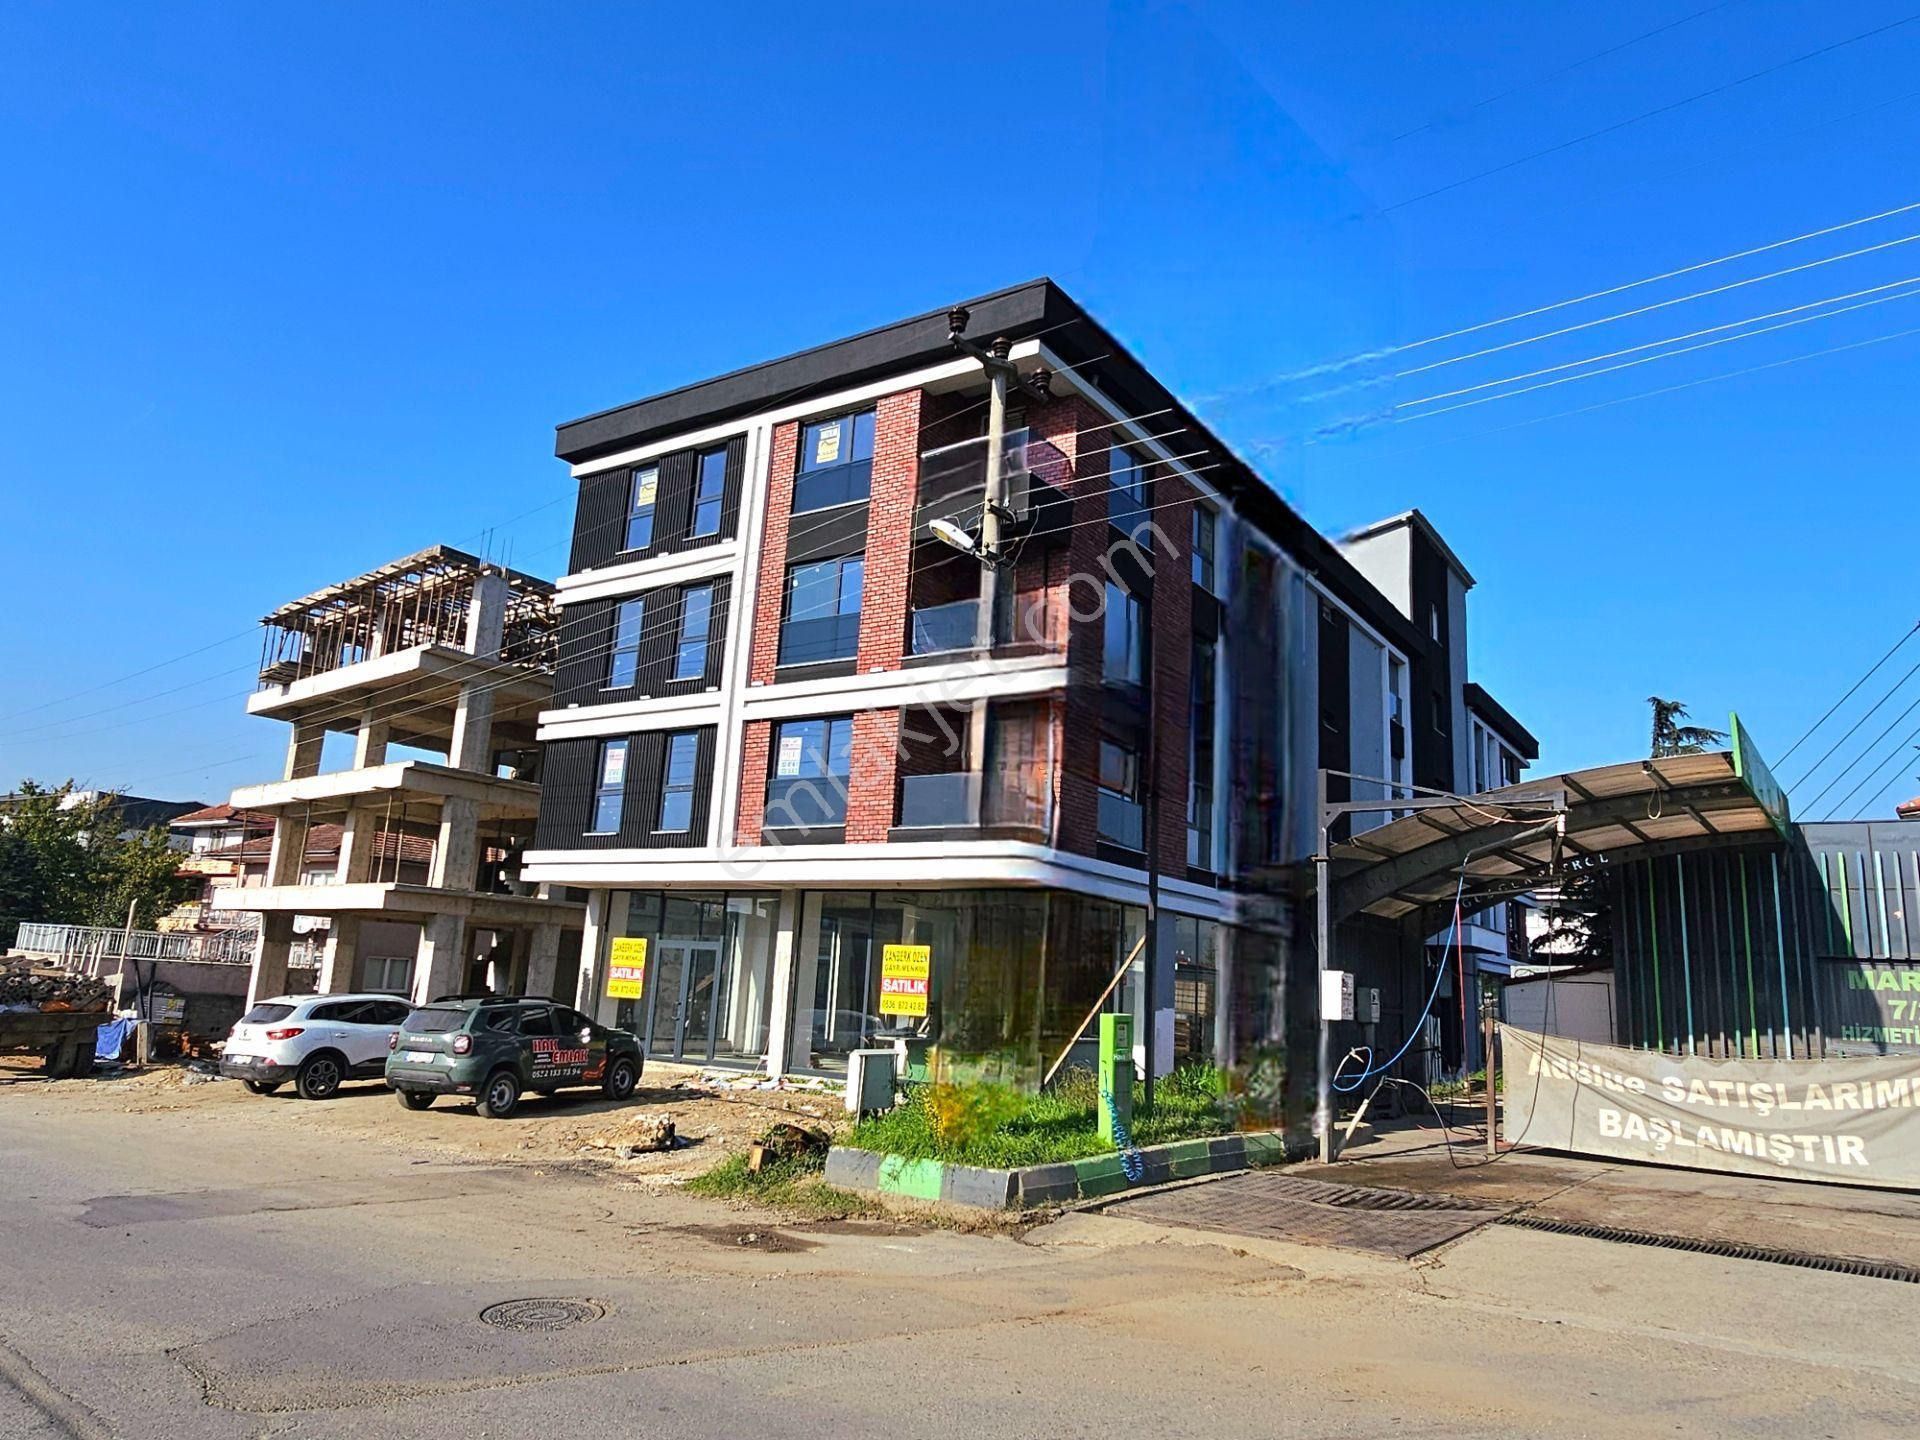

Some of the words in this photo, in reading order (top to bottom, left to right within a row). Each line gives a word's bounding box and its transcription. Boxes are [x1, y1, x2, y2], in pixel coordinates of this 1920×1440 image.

[610, 966, 642, 980] SATILIK
[883, 979, 926, 993] SATILIK
[1888, 999, 1920, 1021] 7/
[552, 1048, 590, 1064] EMLAK
